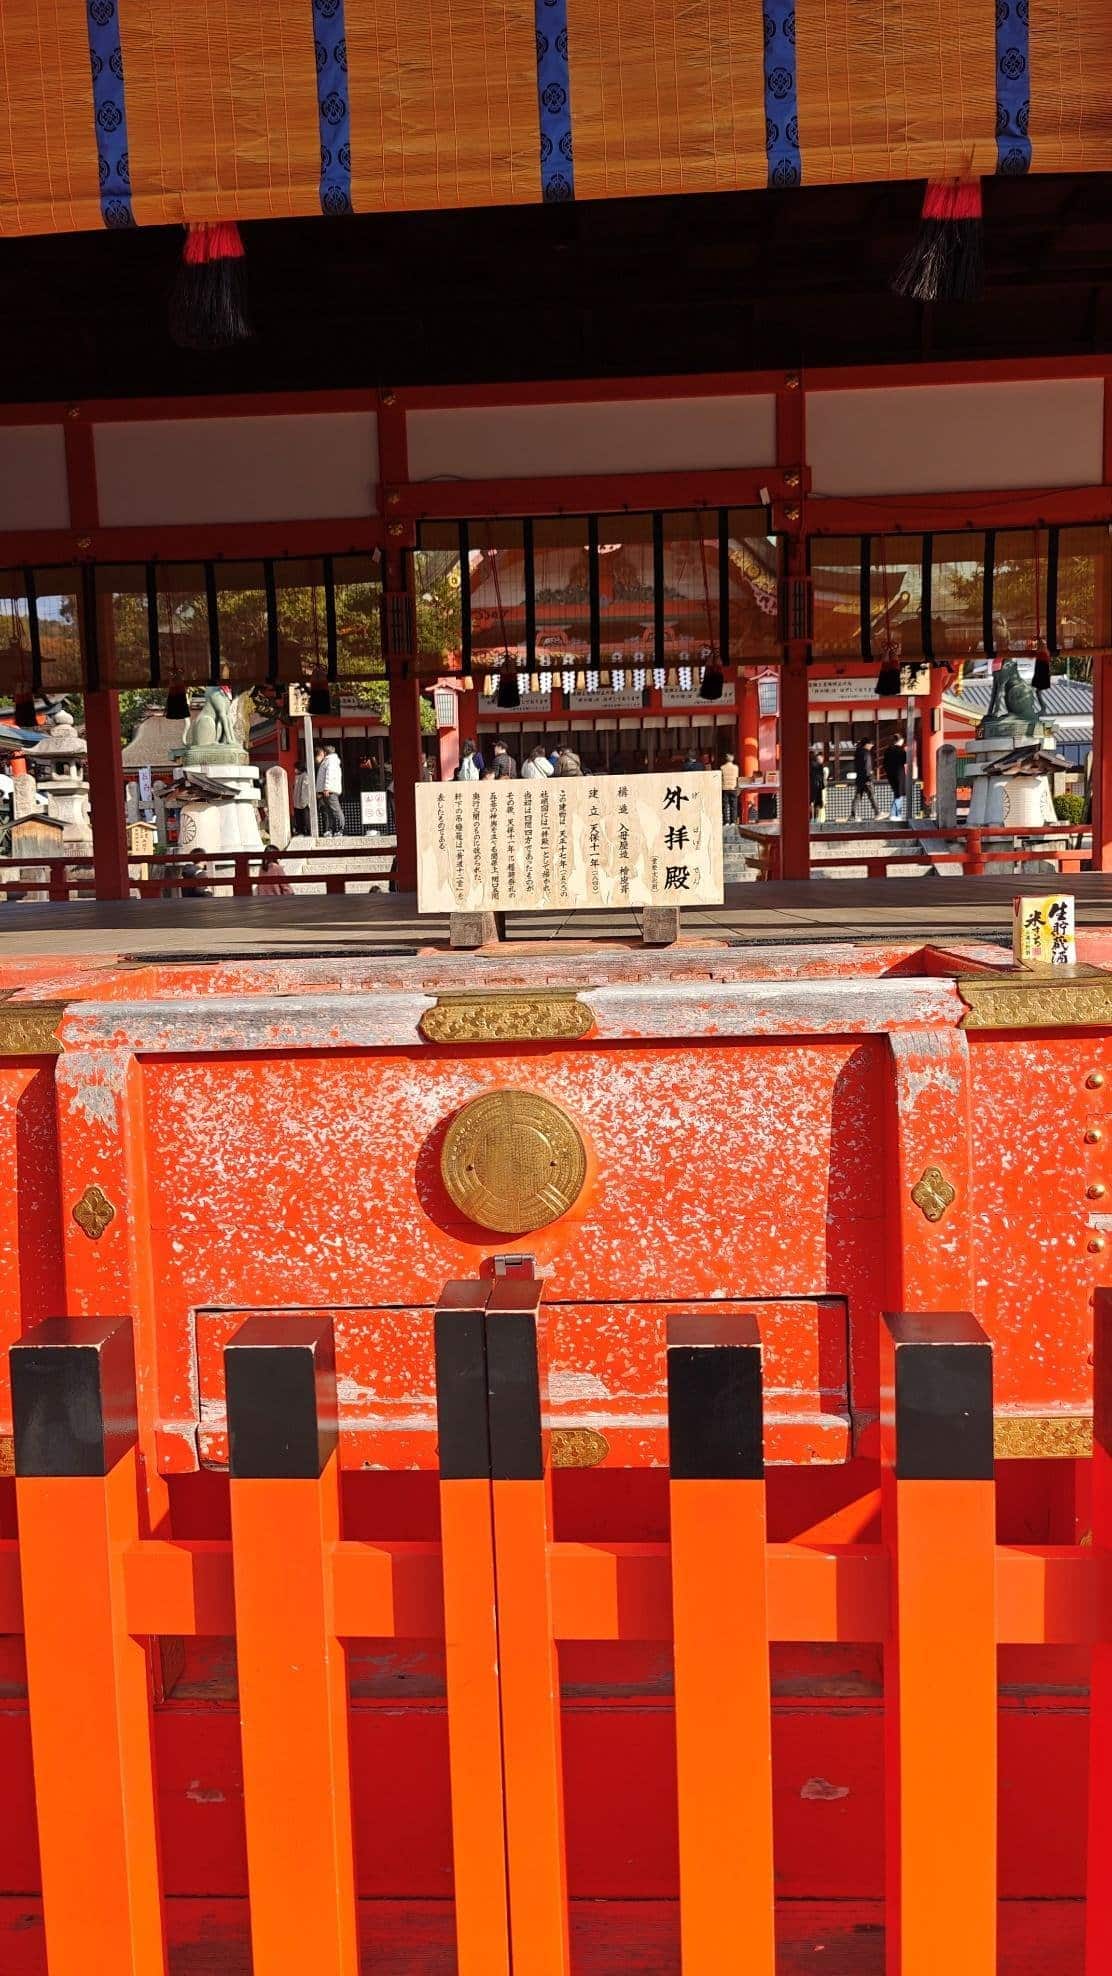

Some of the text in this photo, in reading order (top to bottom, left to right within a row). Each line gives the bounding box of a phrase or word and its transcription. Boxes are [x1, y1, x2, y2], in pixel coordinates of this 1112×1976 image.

[588, 787, 600, 816] 建立
[618, 786, 629, 815] 構造
[618, 823, 630, 859] 入母屋造
[663, 786, 690, 890] 外拝殿
[1048, 901, 1069, 964] 生貯蔵酒
